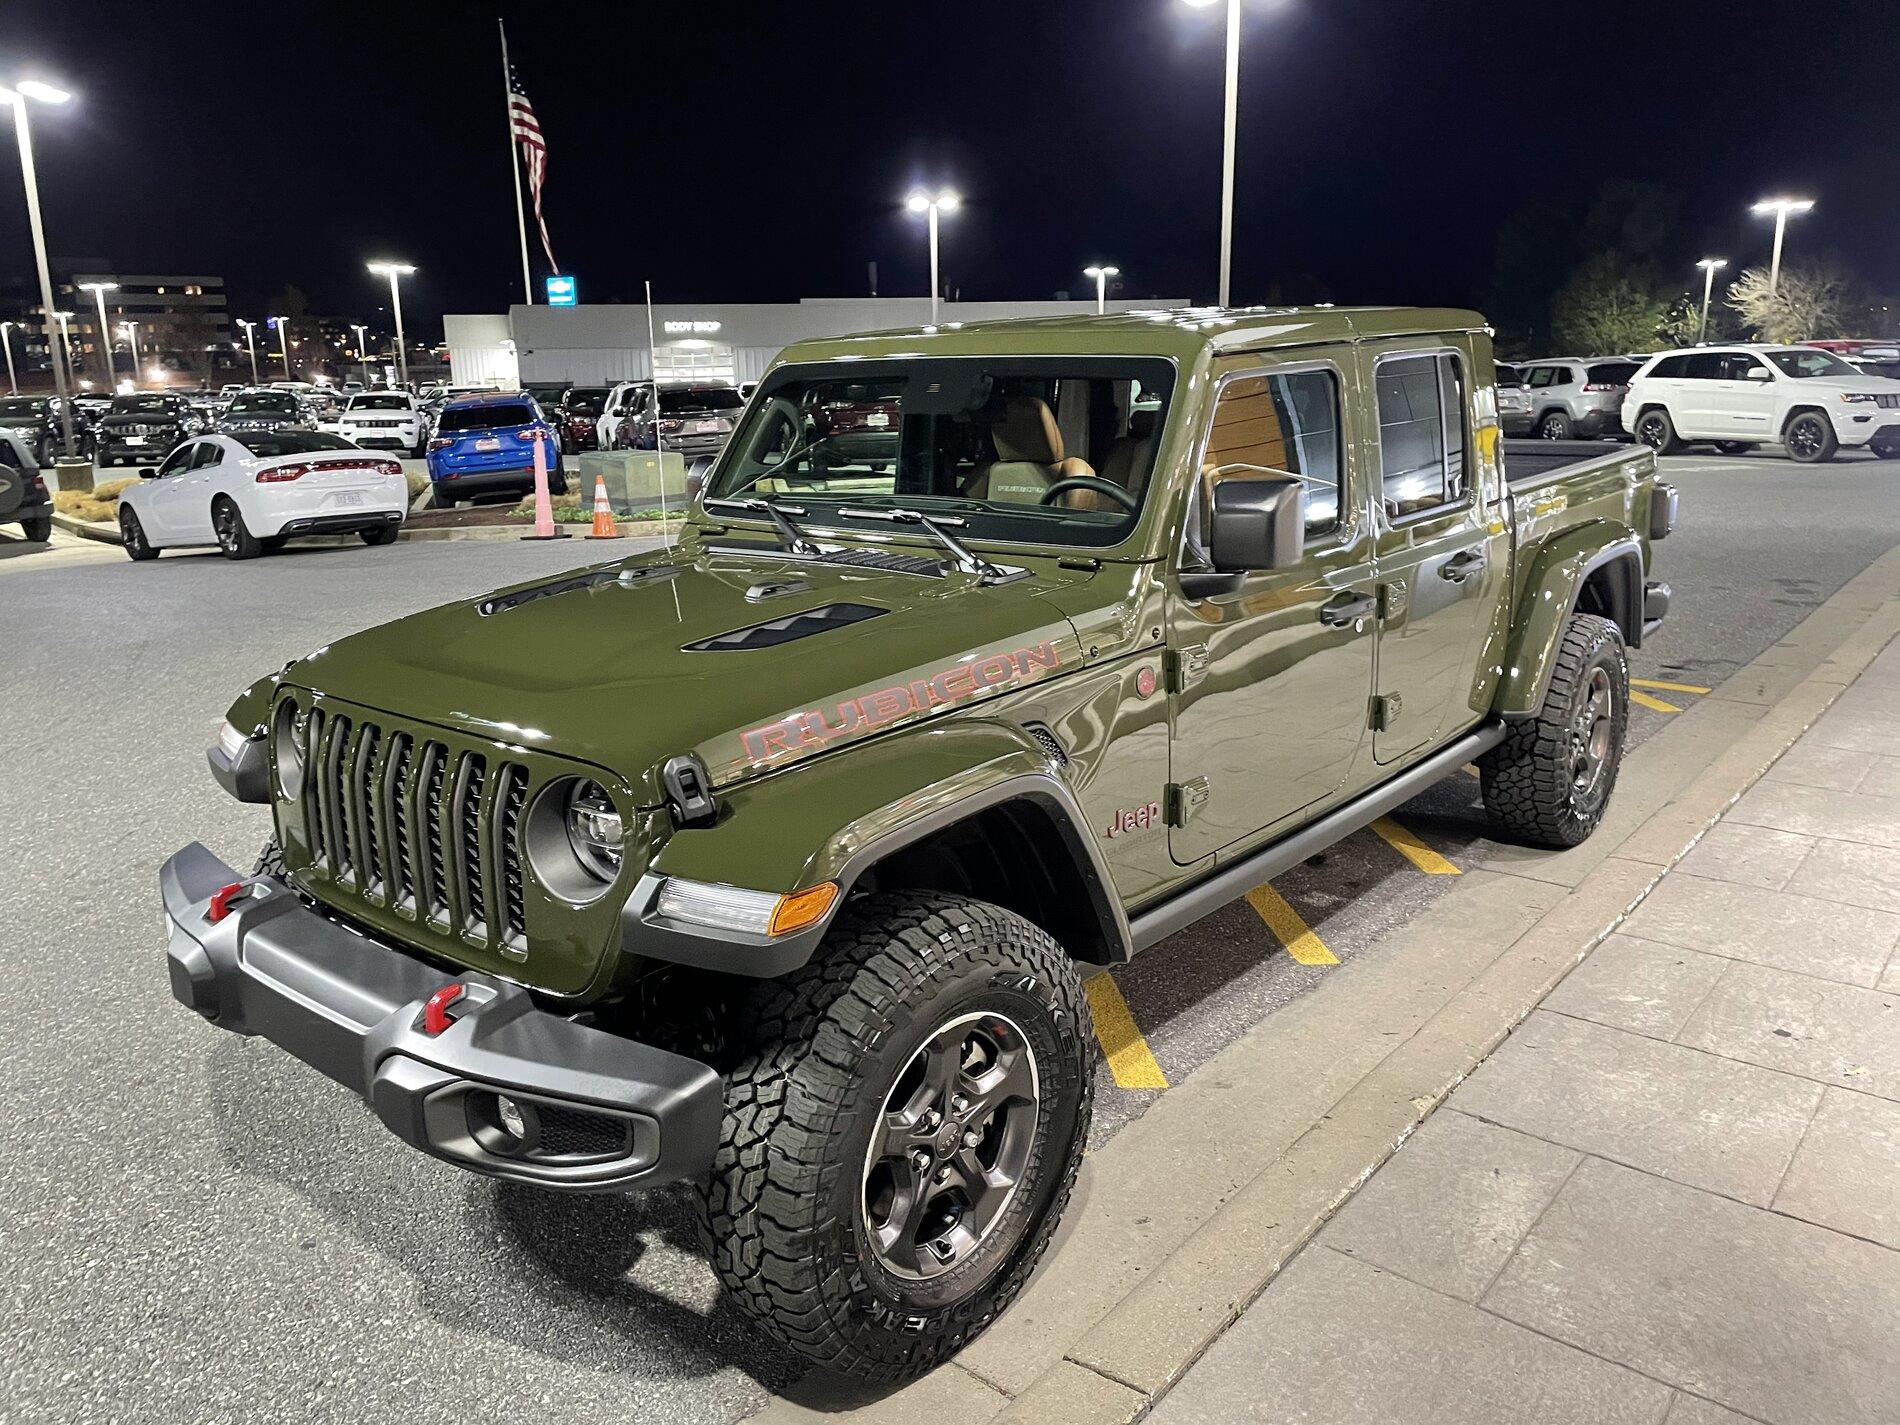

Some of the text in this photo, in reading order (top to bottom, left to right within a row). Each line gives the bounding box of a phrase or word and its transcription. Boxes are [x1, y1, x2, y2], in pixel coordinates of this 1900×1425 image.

[664, 321, 721, 332] BODY SHOP
[740, 638, 1060, 762] RUBICON
[1107, 800, 1161, 839] Jeep
